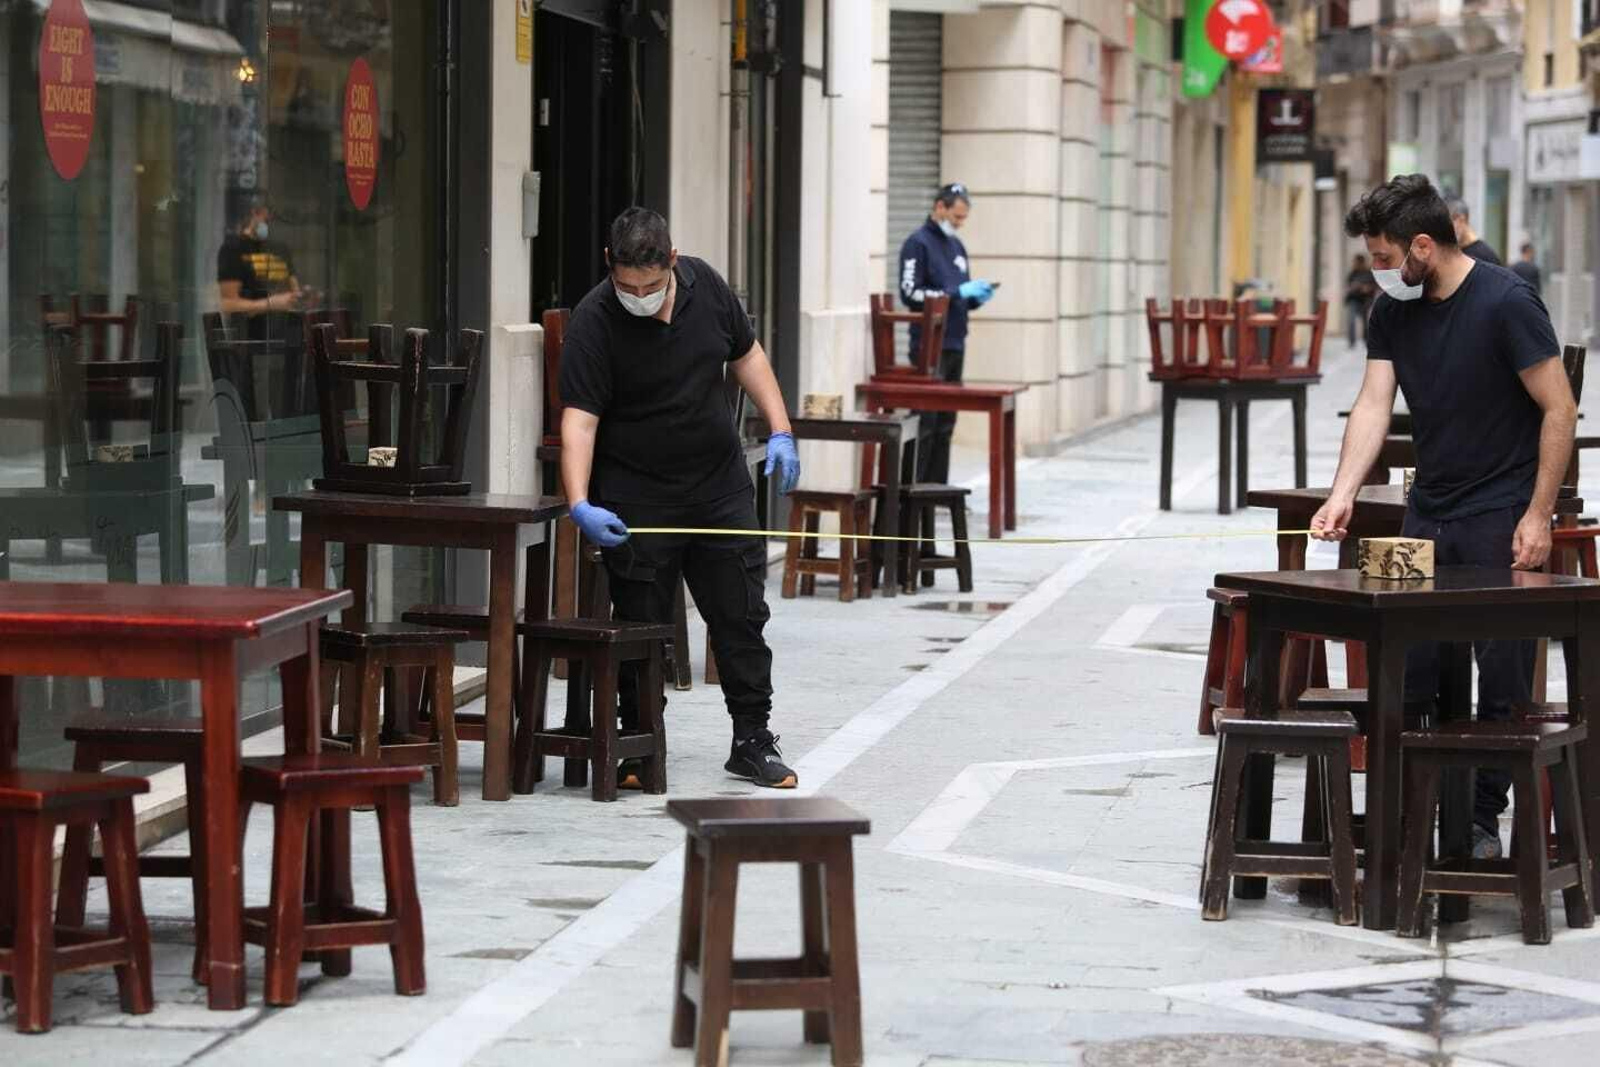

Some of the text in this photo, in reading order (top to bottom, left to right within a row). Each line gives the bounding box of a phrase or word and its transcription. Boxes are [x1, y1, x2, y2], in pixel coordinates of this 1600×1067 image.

[50, 26, 83, 54] EIGHT
[61, 57, 72, 83] IS
[45, 85, 91, 114] ENOUGH
[351, 84, 370, 110] CON
[349, 111, 372, 139] OCHO
[347, 141, 374, 169] BASTA
